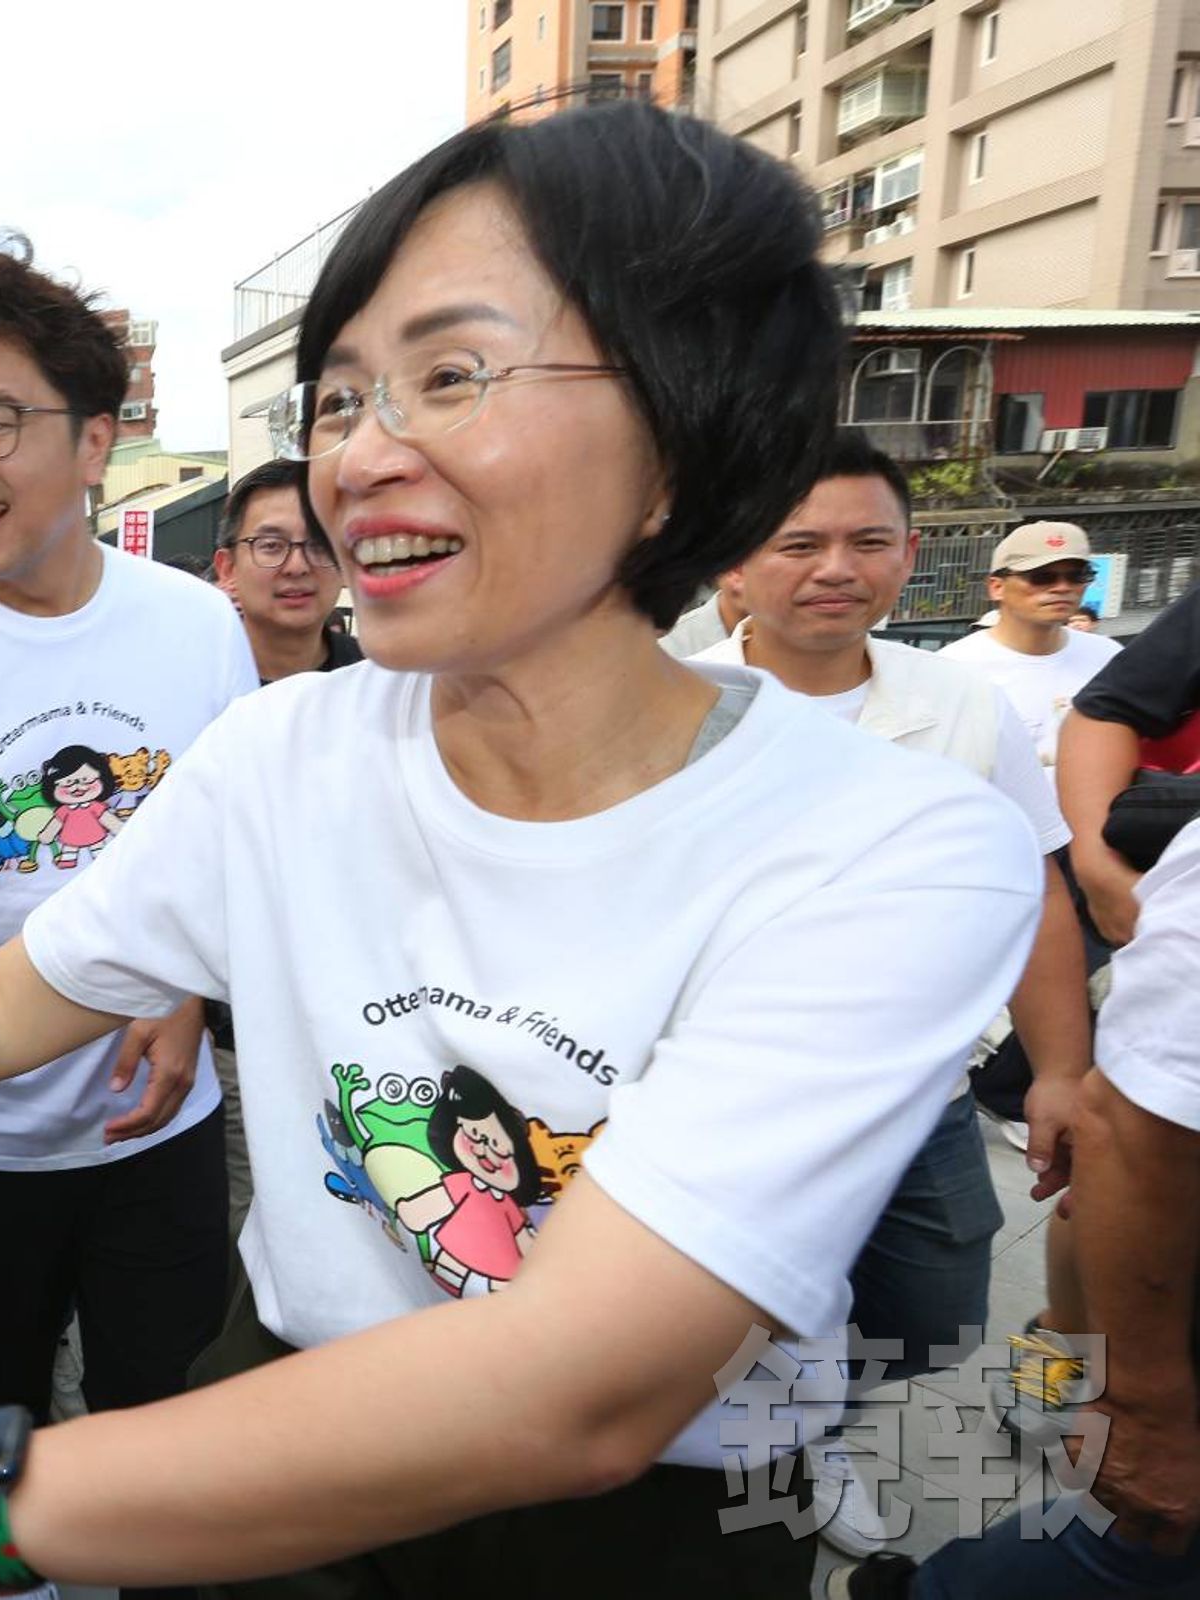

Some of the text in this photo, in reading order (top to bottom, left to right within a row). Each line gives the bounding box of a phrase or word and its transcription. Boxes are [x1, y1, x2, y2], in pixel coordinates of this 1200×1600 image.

[75, 701, 87, 715] &
[92, 702, 146, 732] Friends
[496, 1006, 518, 1025] &
[518, 1011, 620, 1086] Friends
